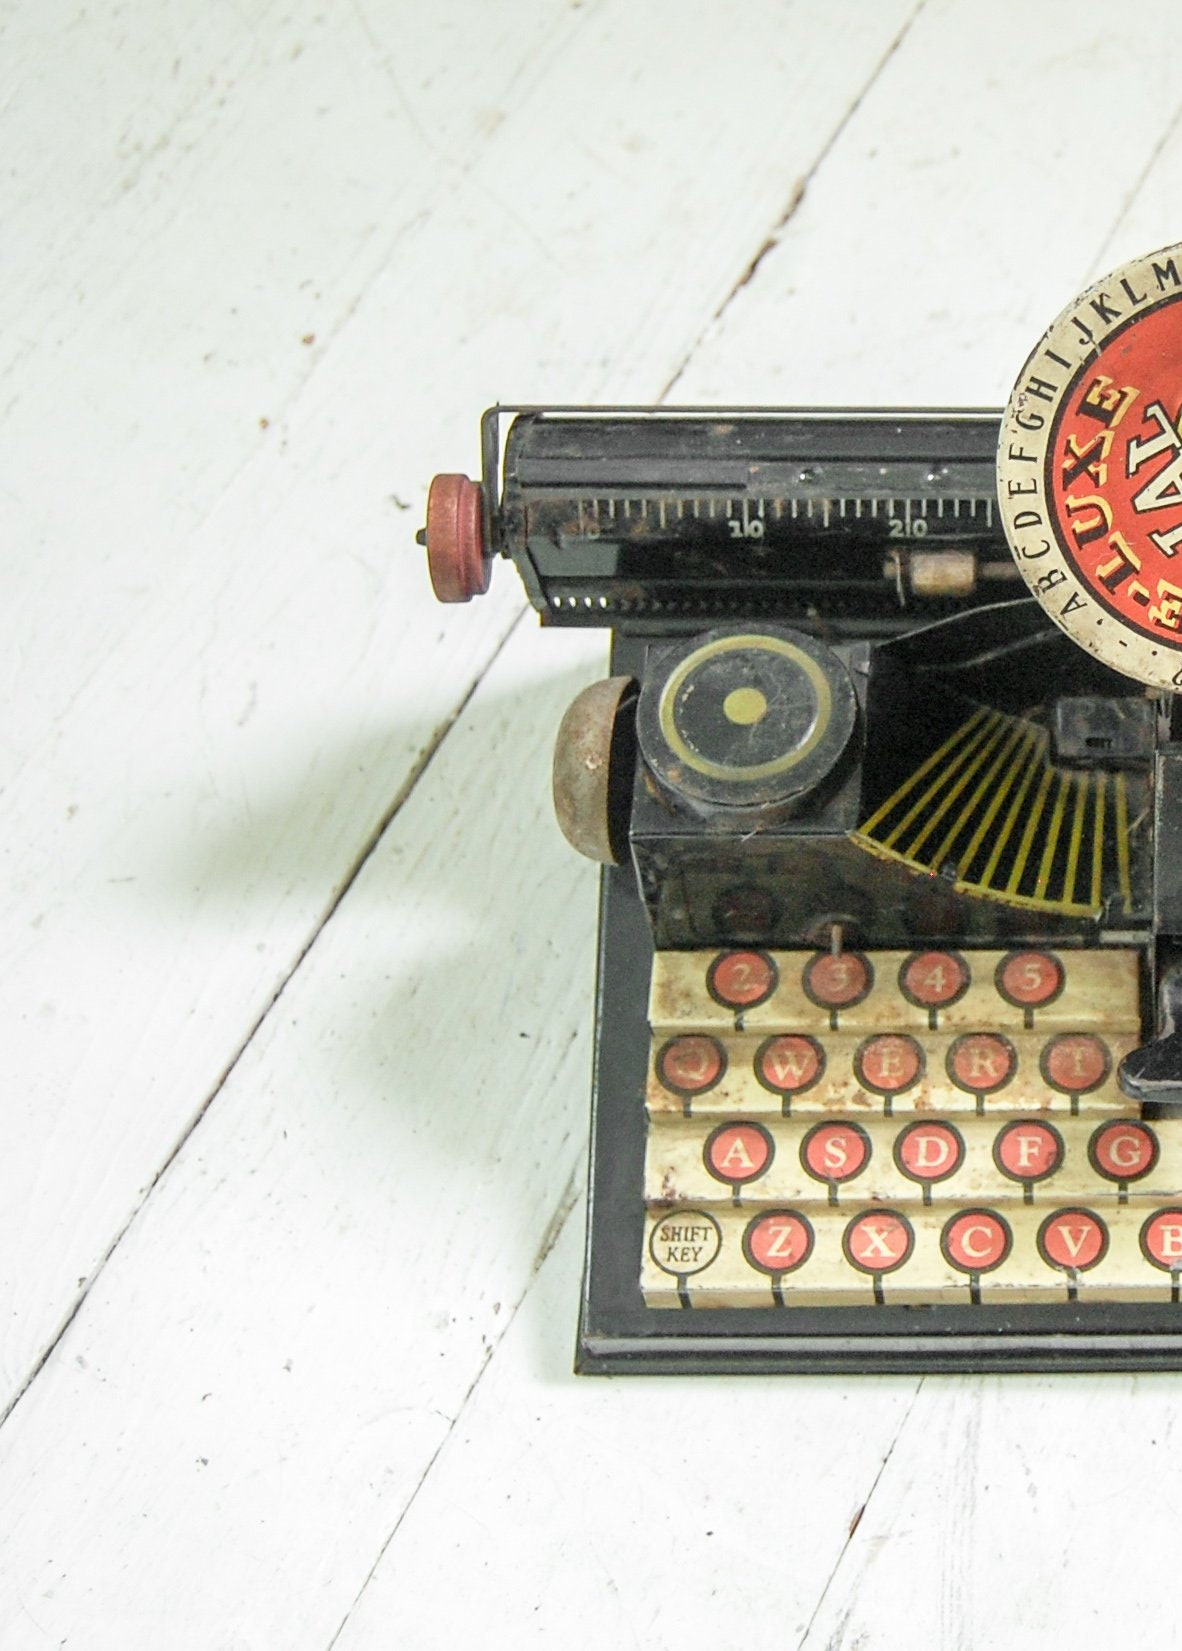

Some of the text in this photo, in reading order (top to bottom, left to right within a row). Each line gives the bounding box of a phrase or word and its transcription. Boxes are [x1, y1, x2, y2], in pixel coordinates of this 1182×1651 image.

[1152, 259, 1182, 291] M
[1119, 278, 1147, 306] L
[1089, 293, 1122, 325] K
[1071, 316, 1095, 345] J
[1025, 376, 1059, 403] H
[1015, 411, 1045, 431] G
[1008, 443, 1038, 463] F
[1008, 478, 1038, 498] E
[1013, 510, 1043, 530] D
[1022, 539, 1051, 560] C
[1036, 568, 1068, 594] B
[1060, 591, 1088, 617] A
[923, 965, 946, 992] 4
[1023, 962, 1044, 988] 5
[770, 1051, 812, 1081] W
[878, 1047, 905, 1078] E
[968, 1047, 999, 1078] R
[1065, 1046, 1092, 1078] T
[720, 1138, 755, 1169] A
[825, 1137, 847, 1169] S
[915, 1136, 949, 1167] D
[1017, 1136, 1043, 1167] F
[1108, 1136, 1142, 1167] G
[659, 1226, 713, 1243] SHIFT
[766, 1225, 794, 1258] Z
[860, 1226, 898, 1258] X
[960, 1225, 993, 1258] C
[1057, 1225, 1092, 1258] V
[666, 1245, 704, 1262] KEY
